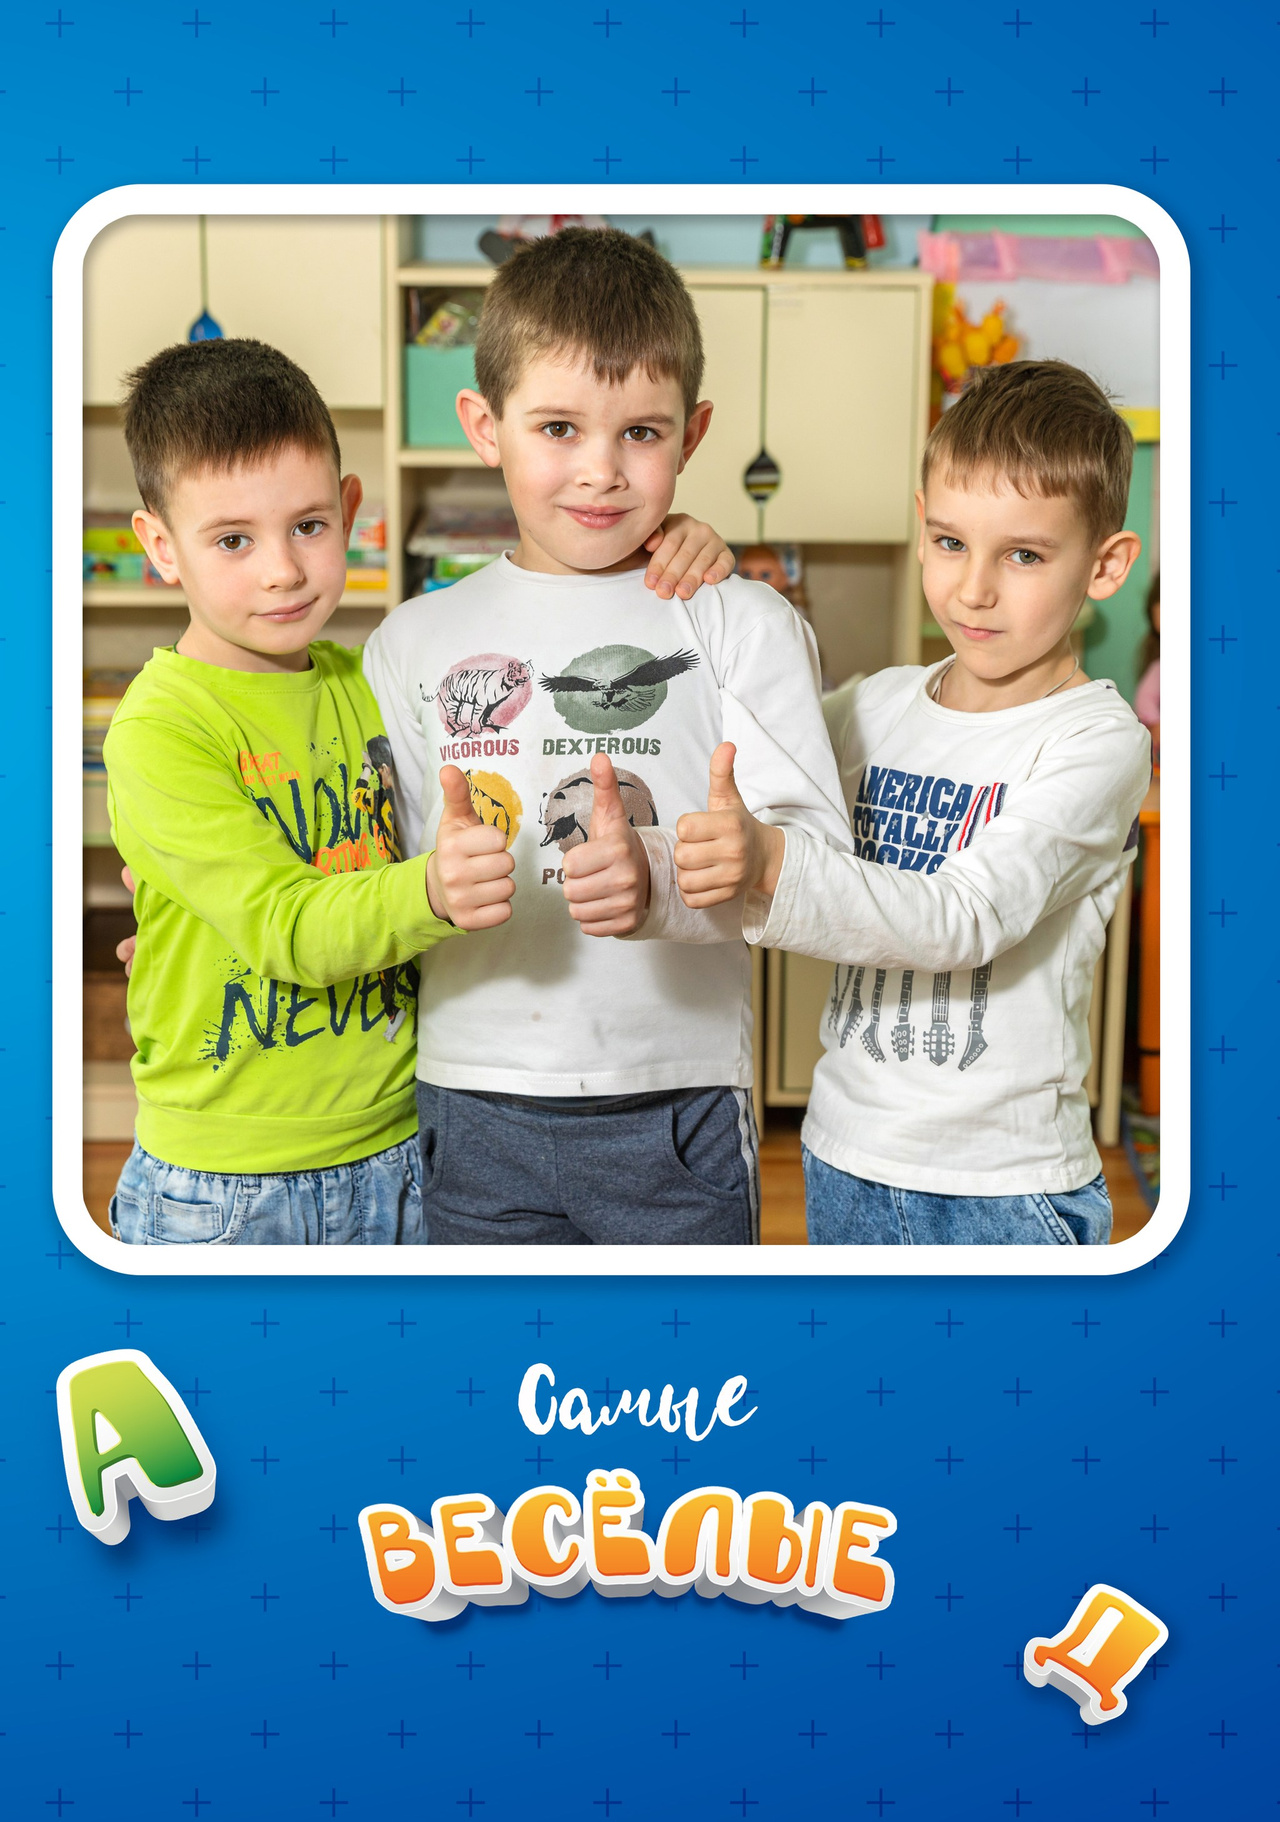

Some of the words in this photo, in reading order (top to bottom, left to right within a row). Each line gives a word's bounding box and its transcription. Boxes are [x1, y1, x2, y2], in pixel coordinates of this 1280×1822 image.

[439, 738, 520, 761] VIGOROUS
[542, 736, 661, 756] DEXTEROUS
[853, 806, 959, 853] TOTALLY
